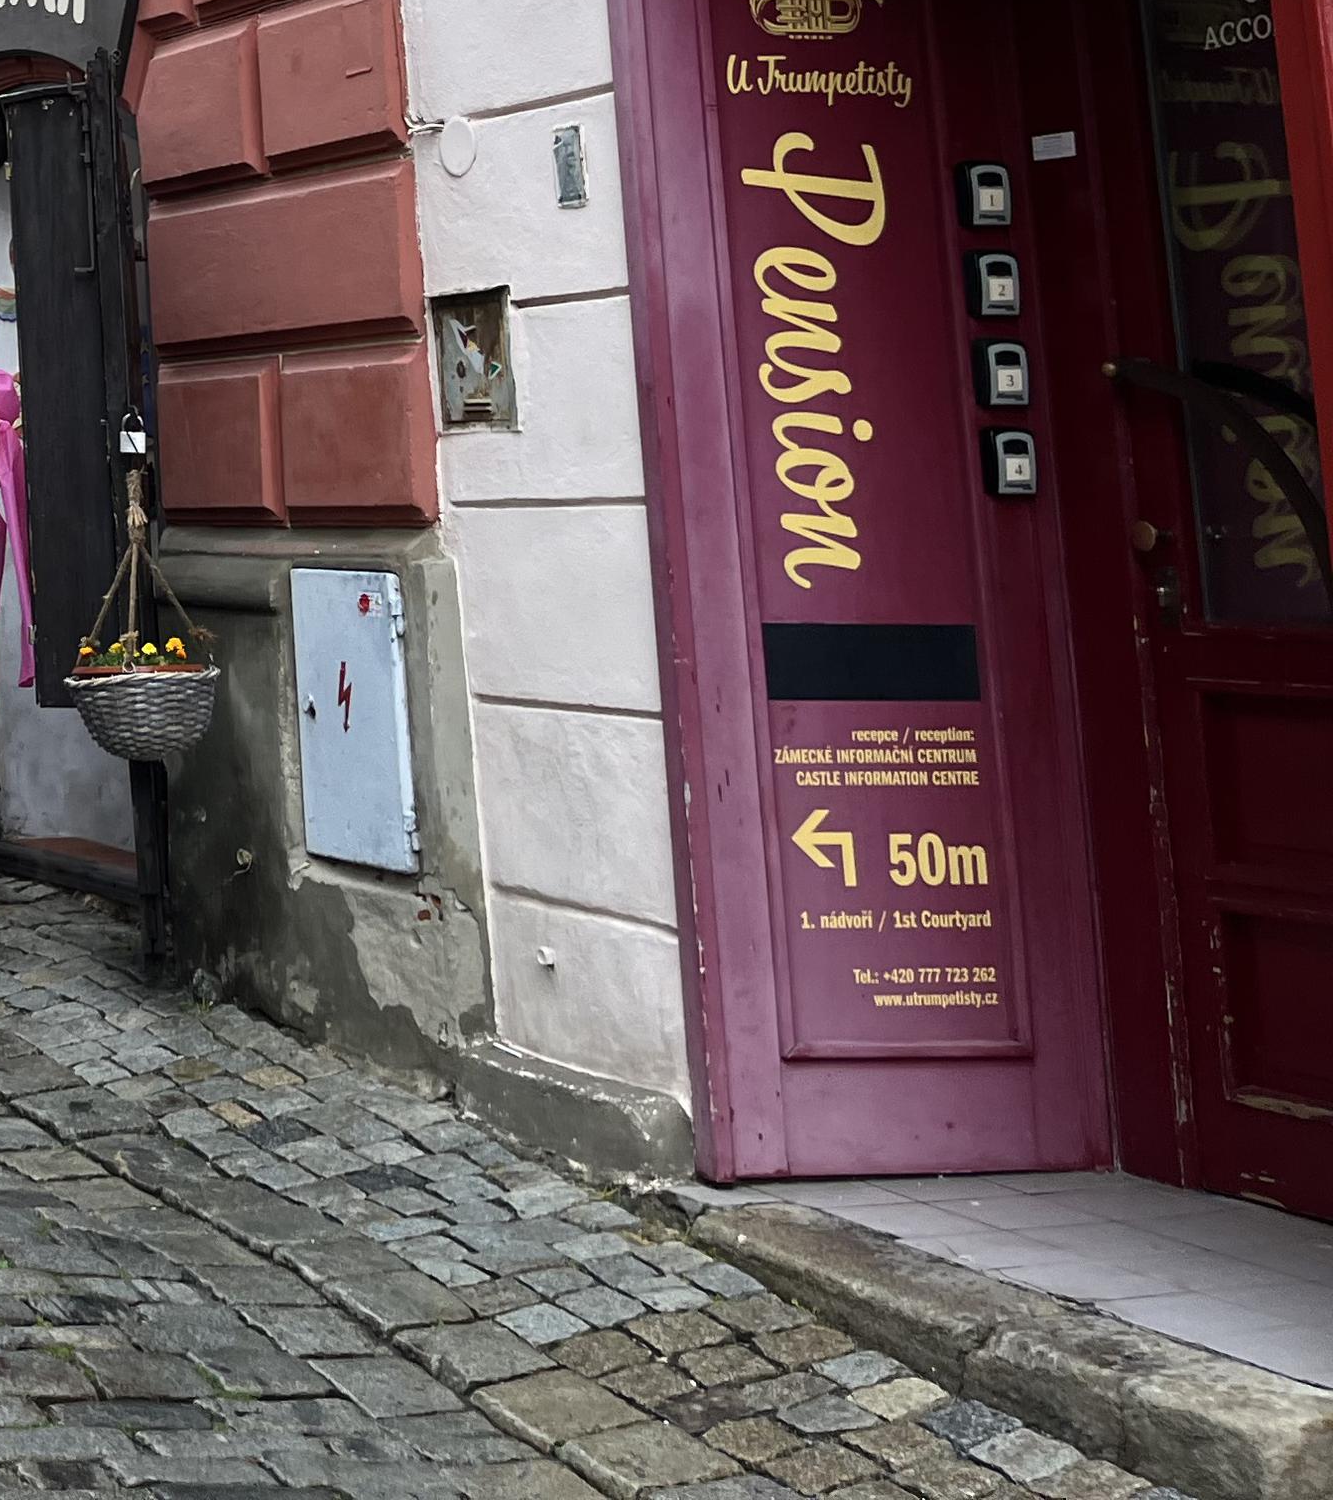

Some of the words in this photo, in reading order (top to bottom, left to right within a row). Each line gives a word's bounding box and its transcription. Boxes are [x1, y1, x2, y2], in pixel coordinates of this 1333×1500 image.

[1203, 14, 1277, 51] ACCO
[726, 54, 754, 95] U
[756, 55, 912, 108] Trumpetisty
[989, 193, 997, 208] 1
[997, 283, 1007, 298] 2
[740, 131, 887, 590] Pension
[1005, 374, 1015, 388] 3
[1014, 463, 1024, 477] 4
[851, 728, 899, 745] recepce
[903, 726, 910, 745] /
[914, 727, 976, 745] reception:
[773, 745, 833, 765] ZÁMECKÉ
[836, 744, 914, 764] INFORMAČNÍ
[917, 748, 978, 764] CENTRUM
[795, 770, 842, 787] CASTLE
[844, 770, 929, 786] INFORMATION
[932, 770, 980, 786] CENTRE
[888, 832, 989, 887] 50m
[799, 910, 816, 930] 1.
[820, 910, 874, 930] nádvoří
[878, 910, 887, 933] /
[892, 910, 918, 929] 1st
[920, 909, 992, 932] Courtyard
[852, 968, 880, 985] Tel.:
[883, 968, 915, 984] +420
[917, 967, 941, 984] 777
[945, 967, 969, 984] 723
[972, 966, 997, 983] 262
[873, 989, 999, 1009] www.utrumpetisty.cz
